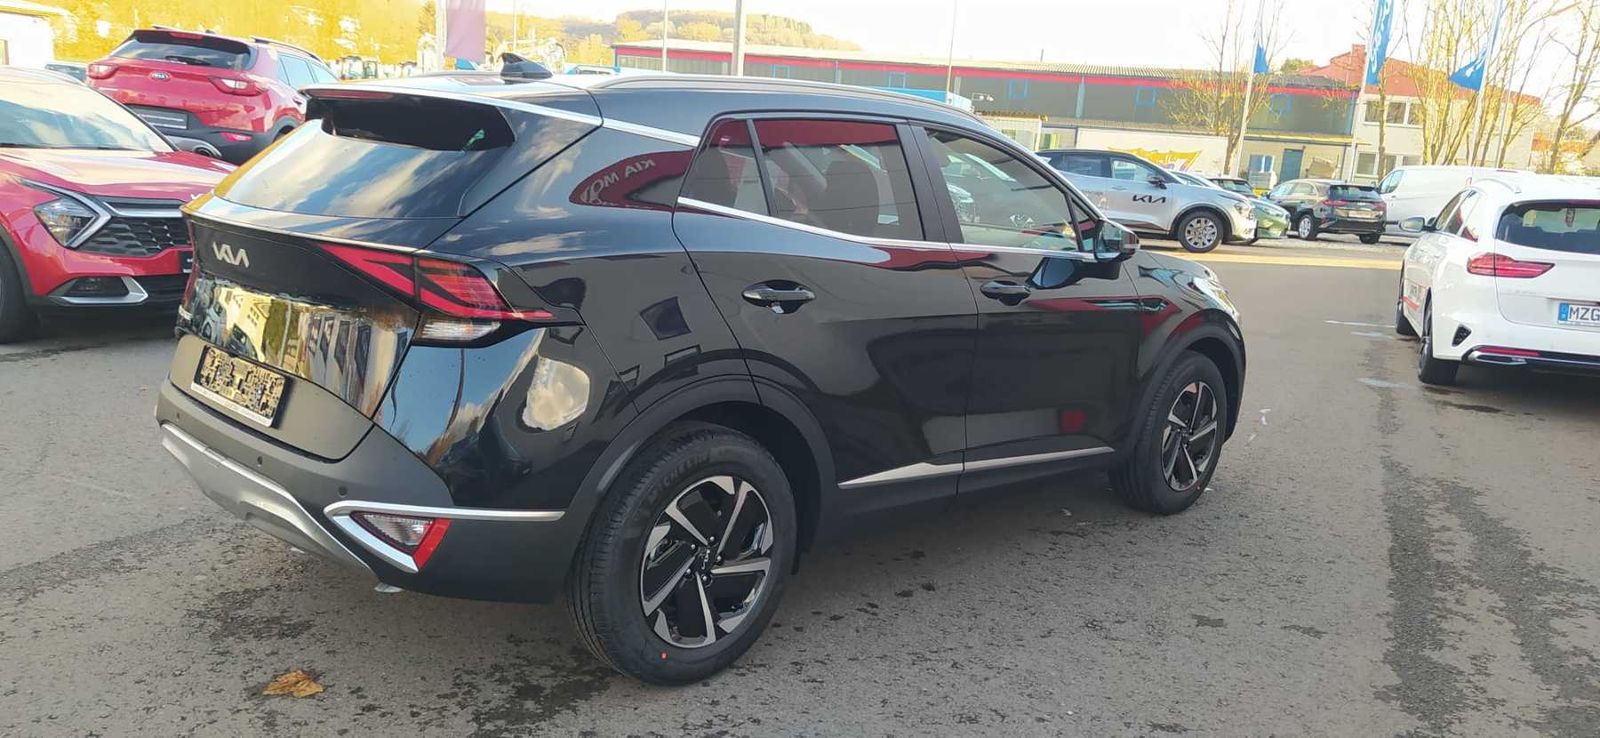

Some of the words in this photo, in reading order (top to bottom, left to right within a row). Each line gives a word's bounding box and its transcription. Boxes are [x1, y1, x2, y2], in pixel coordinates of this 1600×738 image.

[1132, 194, 1167, 204] KIA
[212, 241, 250, 268] KIA
[1569, 306, 1600, 321] MZG
